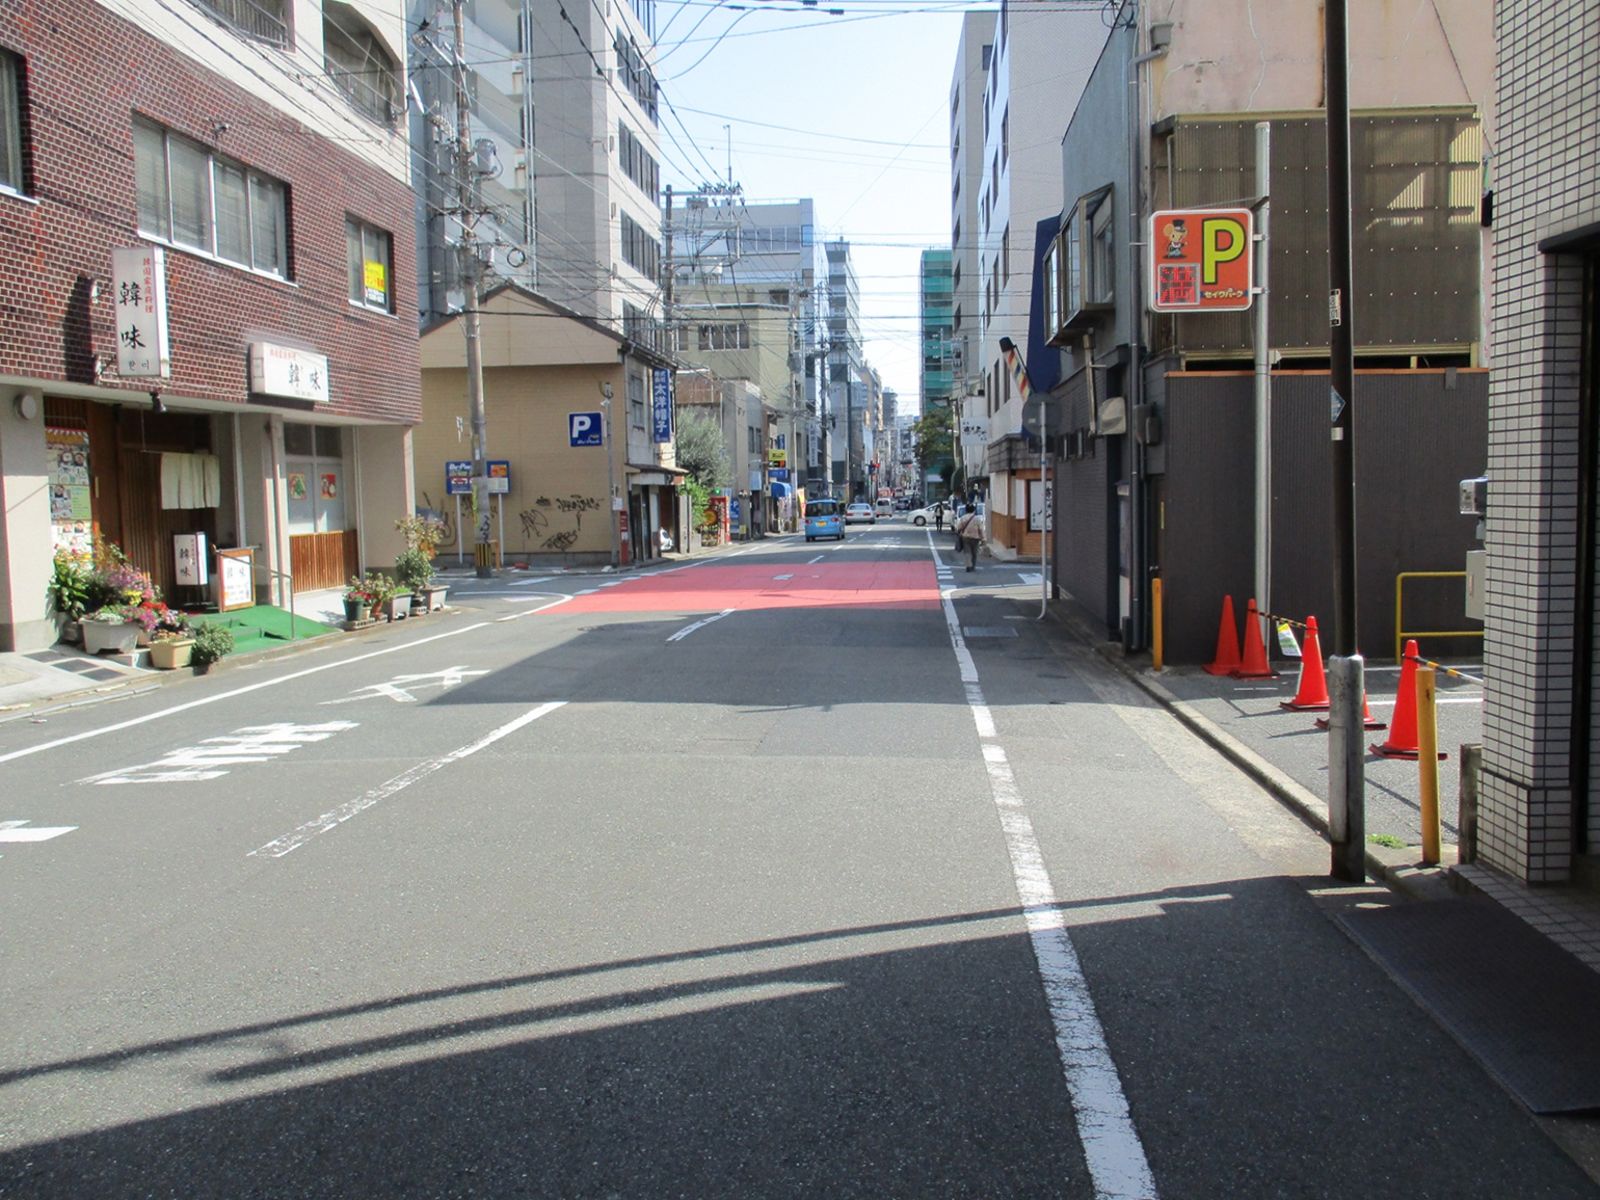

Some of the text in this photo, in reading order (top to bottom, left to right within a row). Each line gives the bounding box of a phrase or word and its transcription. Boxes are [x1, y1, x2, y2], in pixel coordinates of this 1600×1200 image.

[1203, 217, 1246, 285] P
[119, 281, 146, 349] 韓味
[572, 415, 591, 438] P
